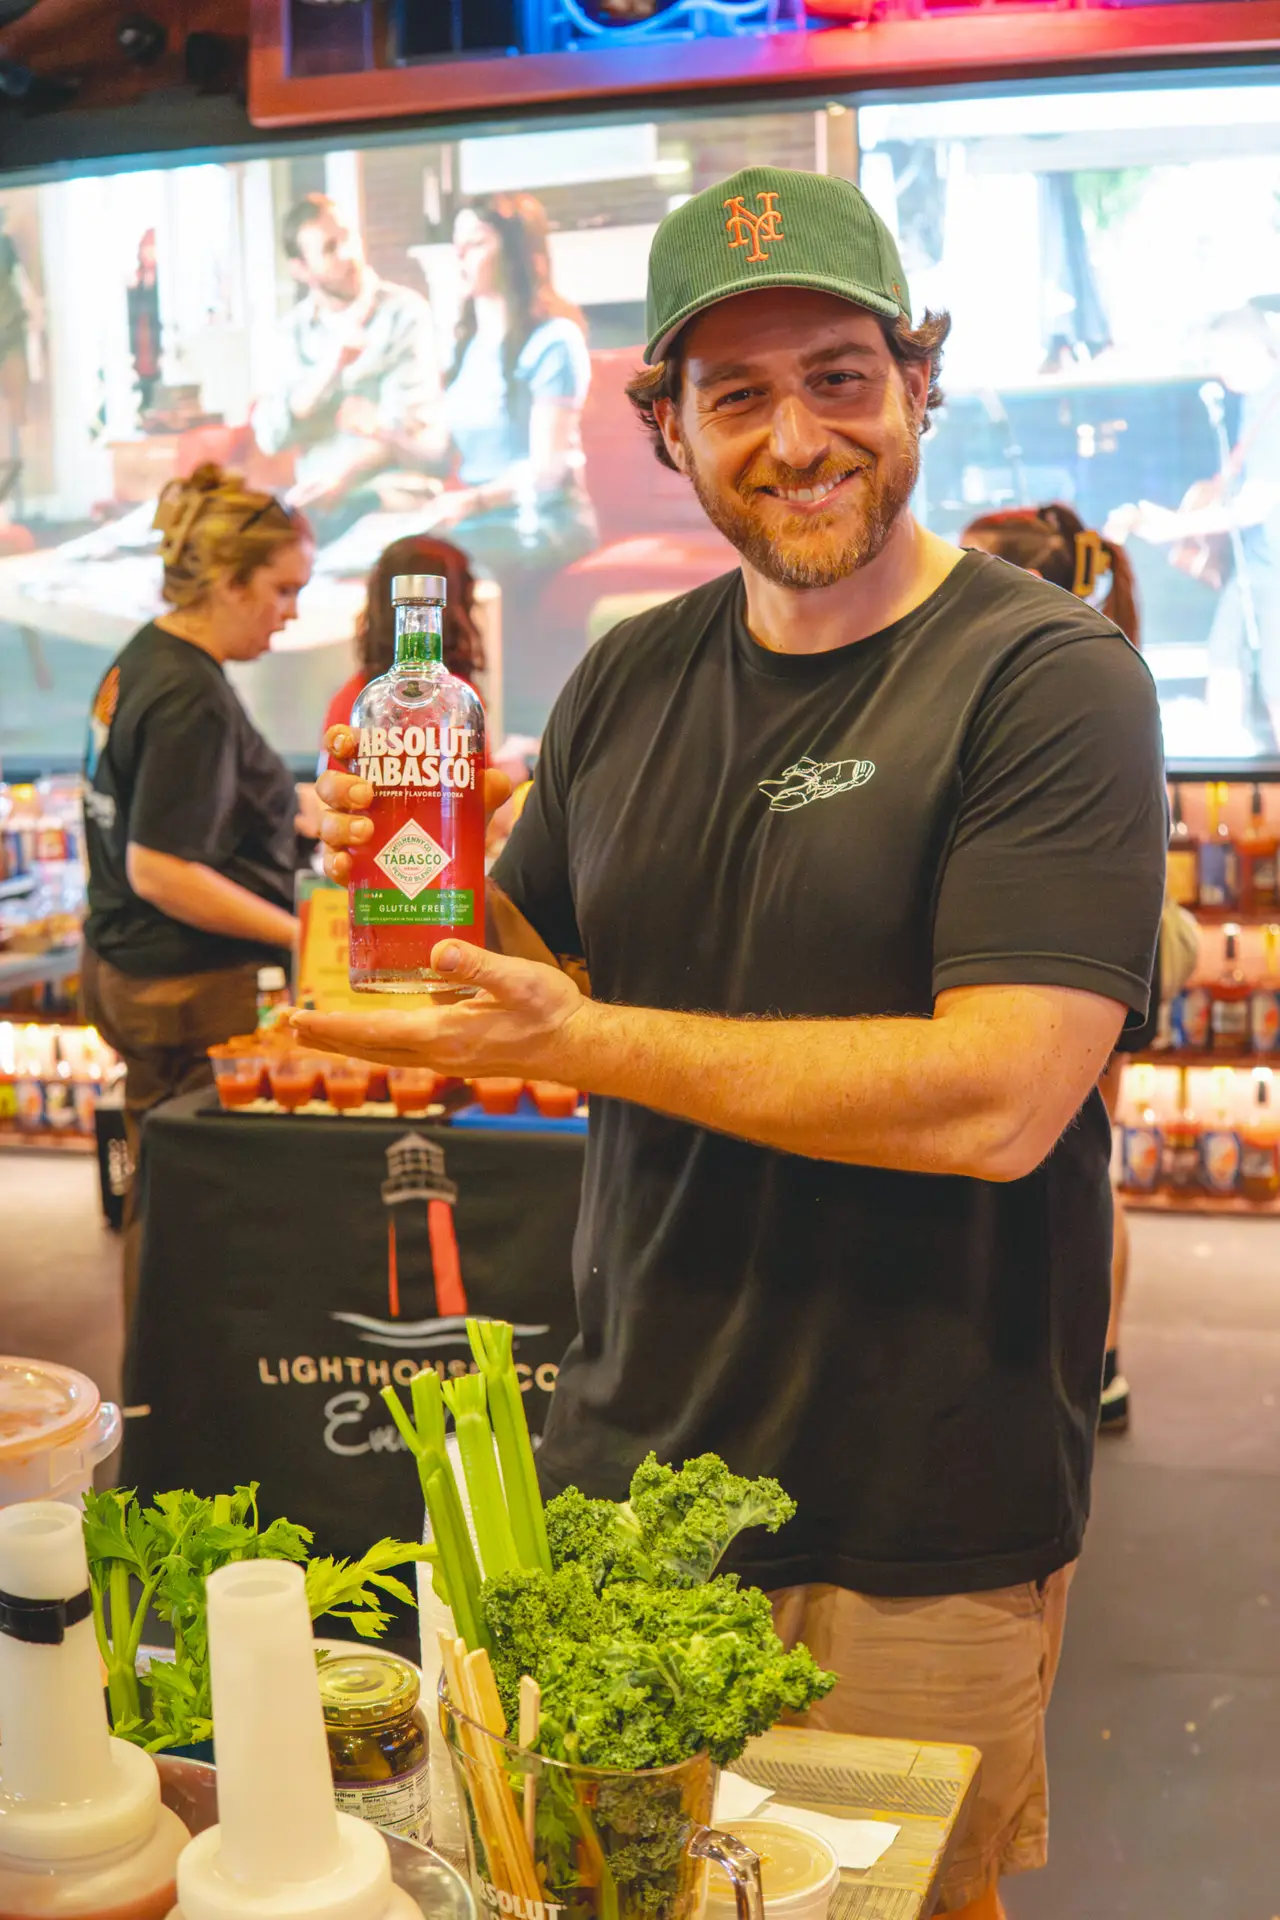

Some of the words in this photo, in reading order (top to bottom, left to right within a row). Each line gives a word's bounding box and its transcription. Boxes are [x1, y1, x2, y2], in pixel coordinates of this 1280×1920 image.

[358, 726, 471, 757] ABSOLUT
[358, 756, 470, 788] TABASCO
[405, 790, 441, 798] FLAVORED
[383, 854, 442, 865] TABASCO
[379, 904, 417, 913] GLUTEN
[421, 904, 446, 913] FREE
[258, 1355, 480, 1387] LIGHTHOUS
